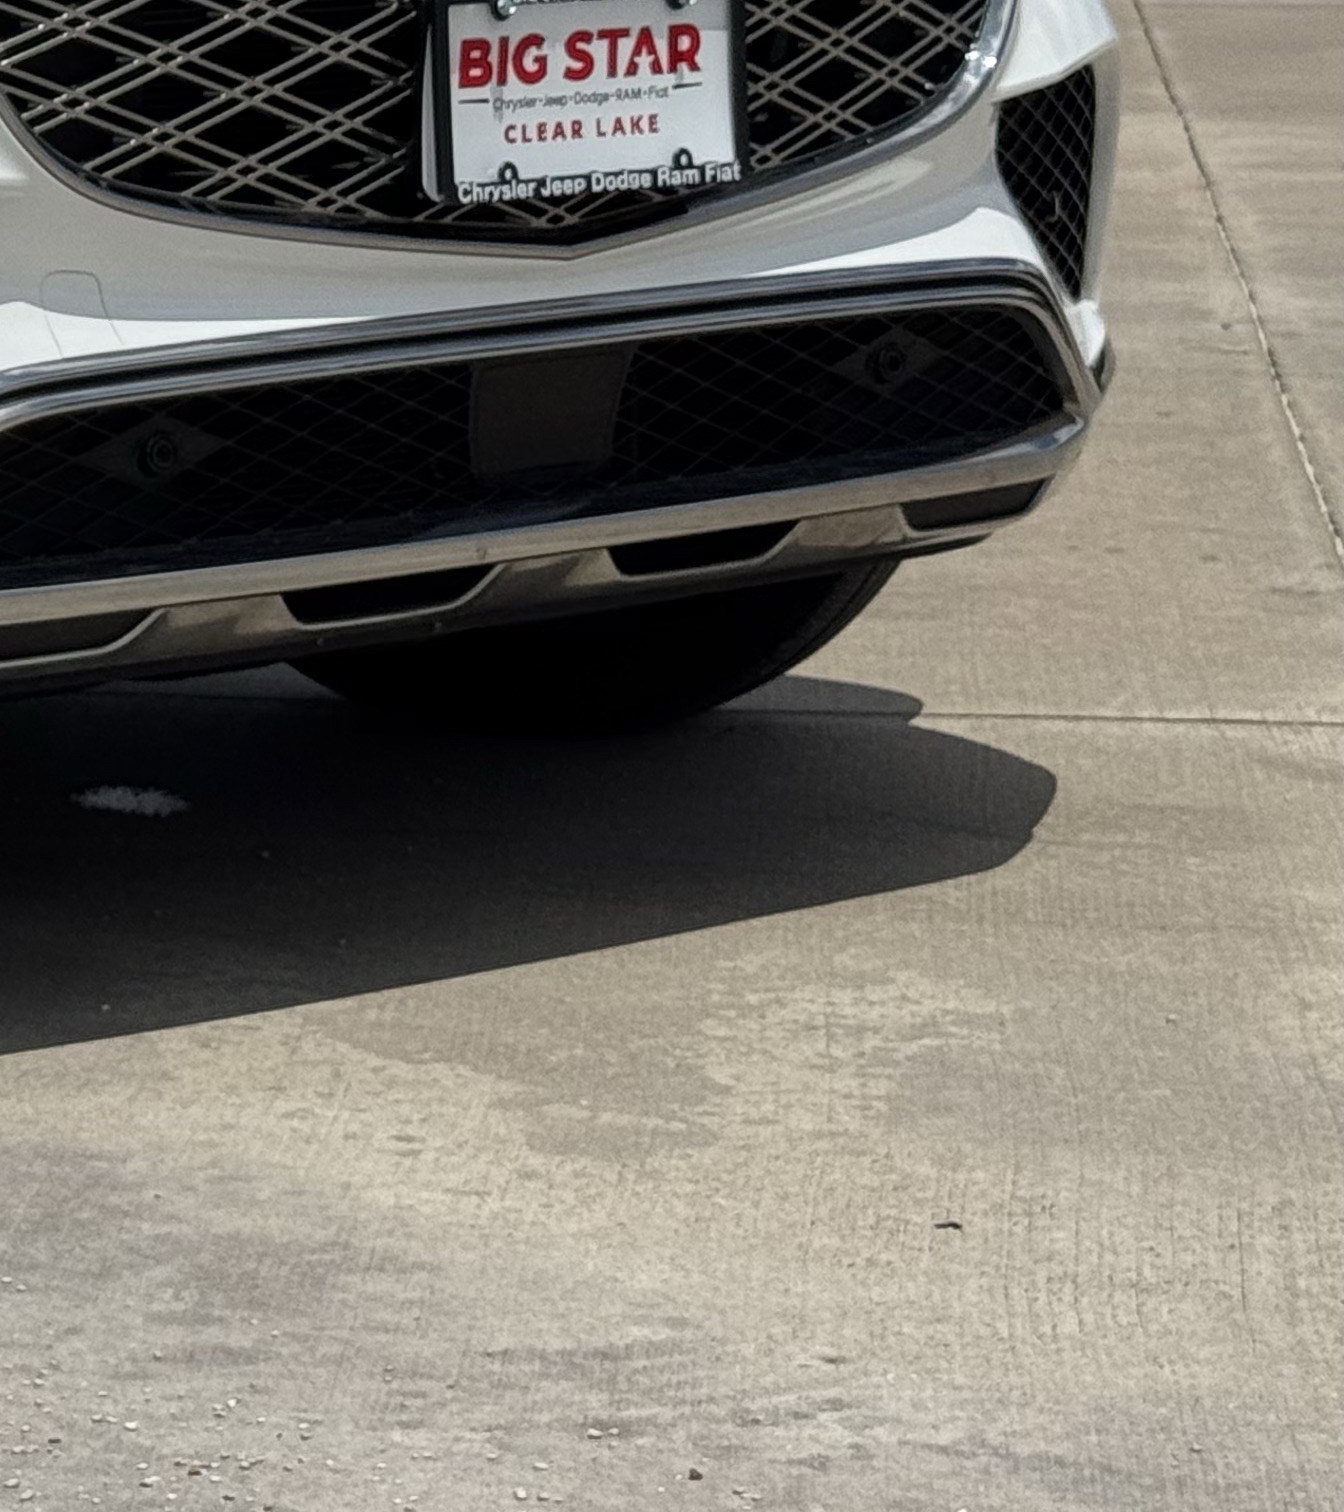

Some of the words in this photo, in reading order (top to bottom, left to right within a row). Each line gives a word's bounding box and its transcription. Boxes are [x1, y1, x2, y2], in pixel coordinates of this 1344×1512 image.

[458, 32, 548, 89] BIG
[562, 22, 702, 82] STAR
[503, 119, 584, 145] CLEAR
[595, 112, 661, 138] LAKE
[456, 178, 538, 205] Chrysler
[539, 174, 588, 197] Jeep
[590, 169, 653, 195] Dodge
[656, 164, 701, 188] Ram
[703, 159, 742, 184] Fiat
